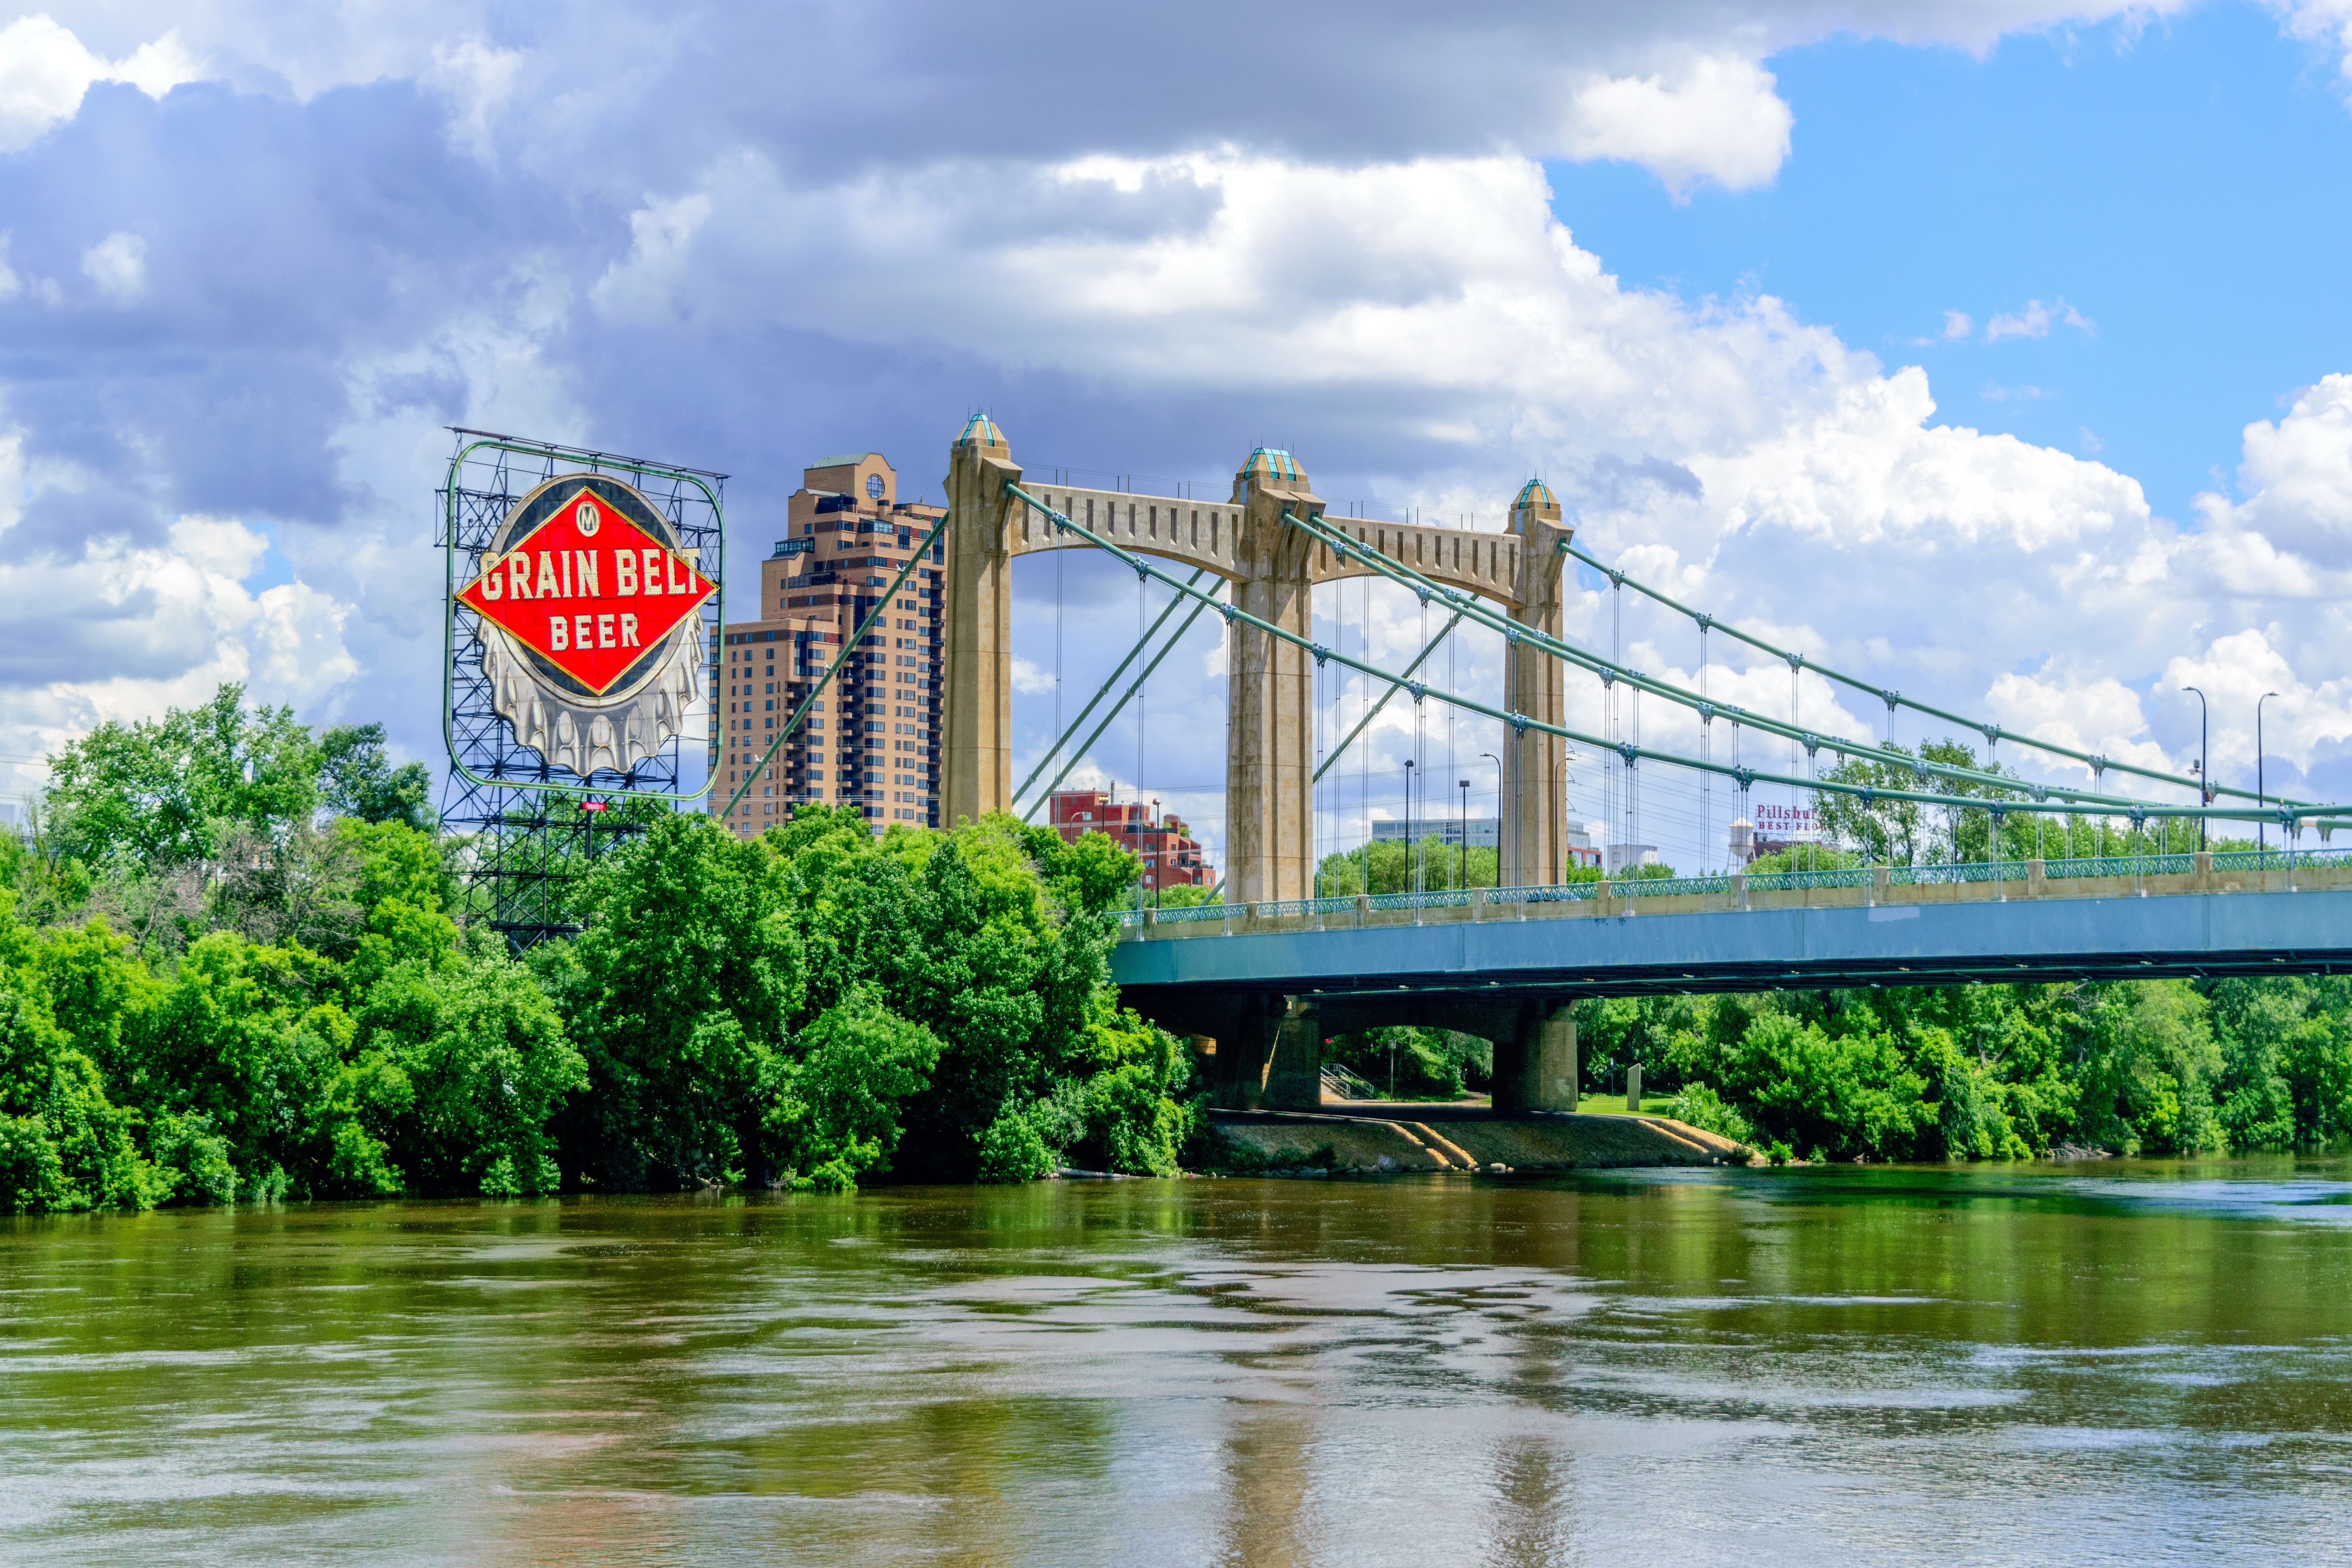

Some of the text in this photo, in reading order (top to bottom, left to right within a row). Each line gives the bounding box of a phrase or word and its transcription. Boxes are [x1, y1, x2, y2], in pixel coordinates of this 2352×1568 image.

[480, 548, 701, 600] GRAIN BELT
[549, 613, 641, 652] BEER
[1758, 805, 1824, 820] Pillsbur
[1759, 822, 1789, 830] BEST
